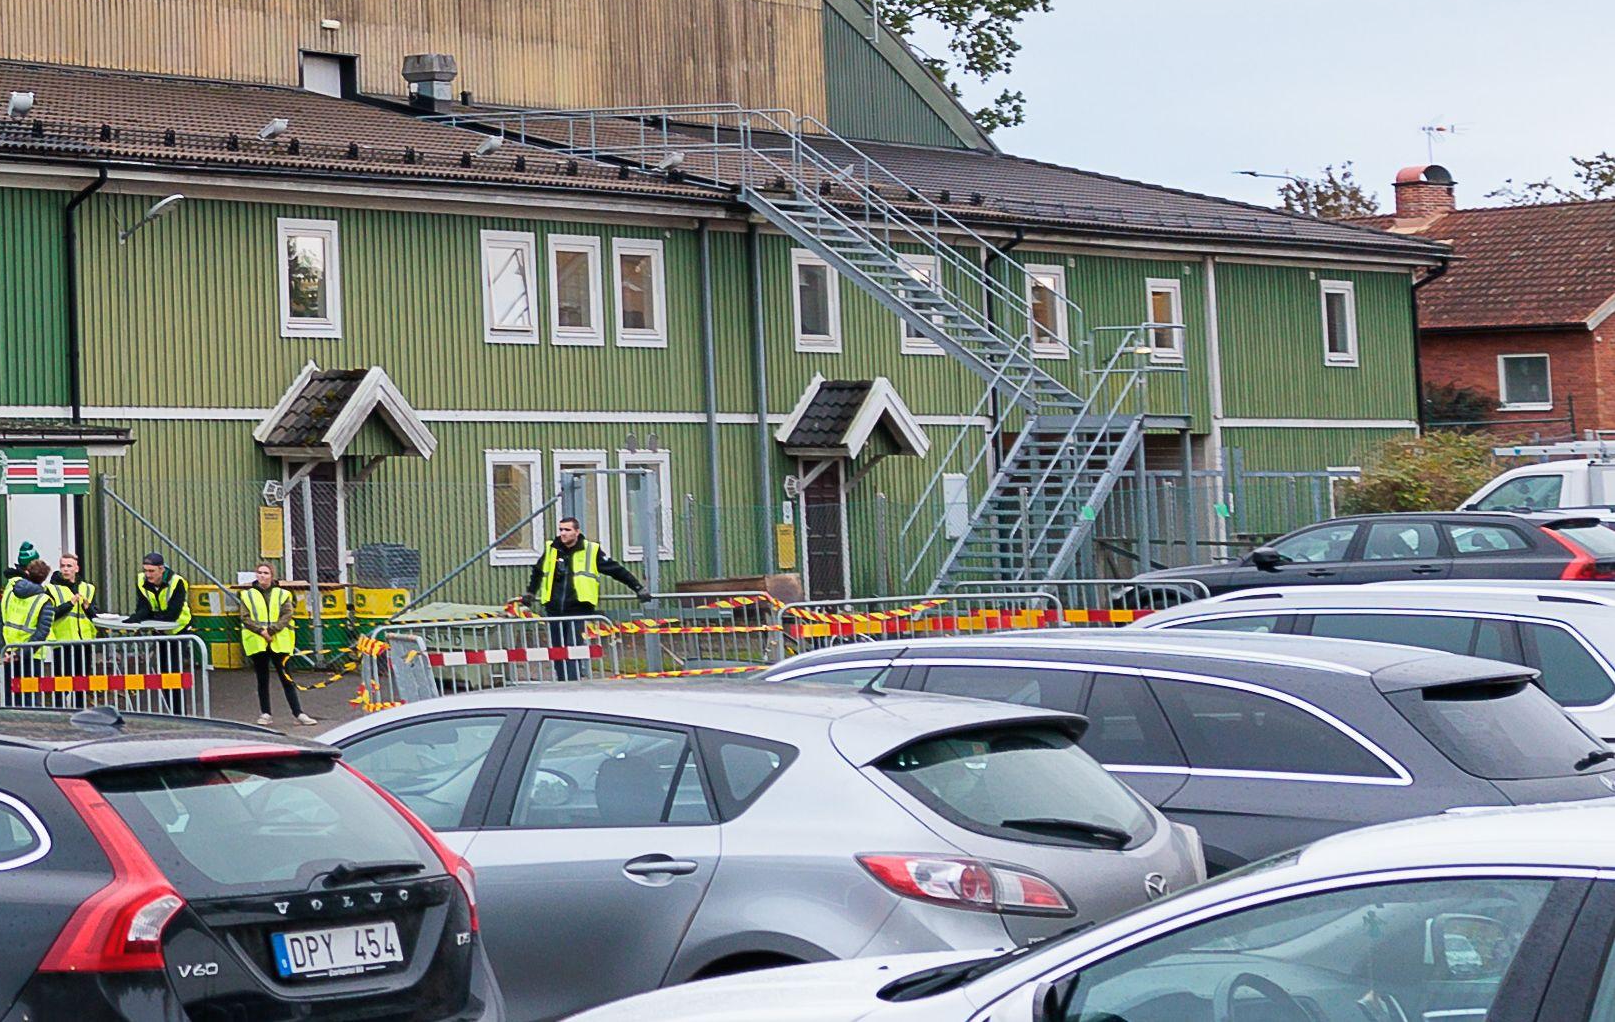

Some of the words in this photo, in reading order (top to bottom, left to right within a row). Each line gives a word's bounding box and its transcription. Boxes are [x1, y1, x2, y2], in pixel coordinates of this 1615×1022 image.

[274, 889, 409, 914] VOLVO
[289, 933, 334, 968] DPY
[355, 927, 396, 960] 454
[177, 962, 219, 978] V60
